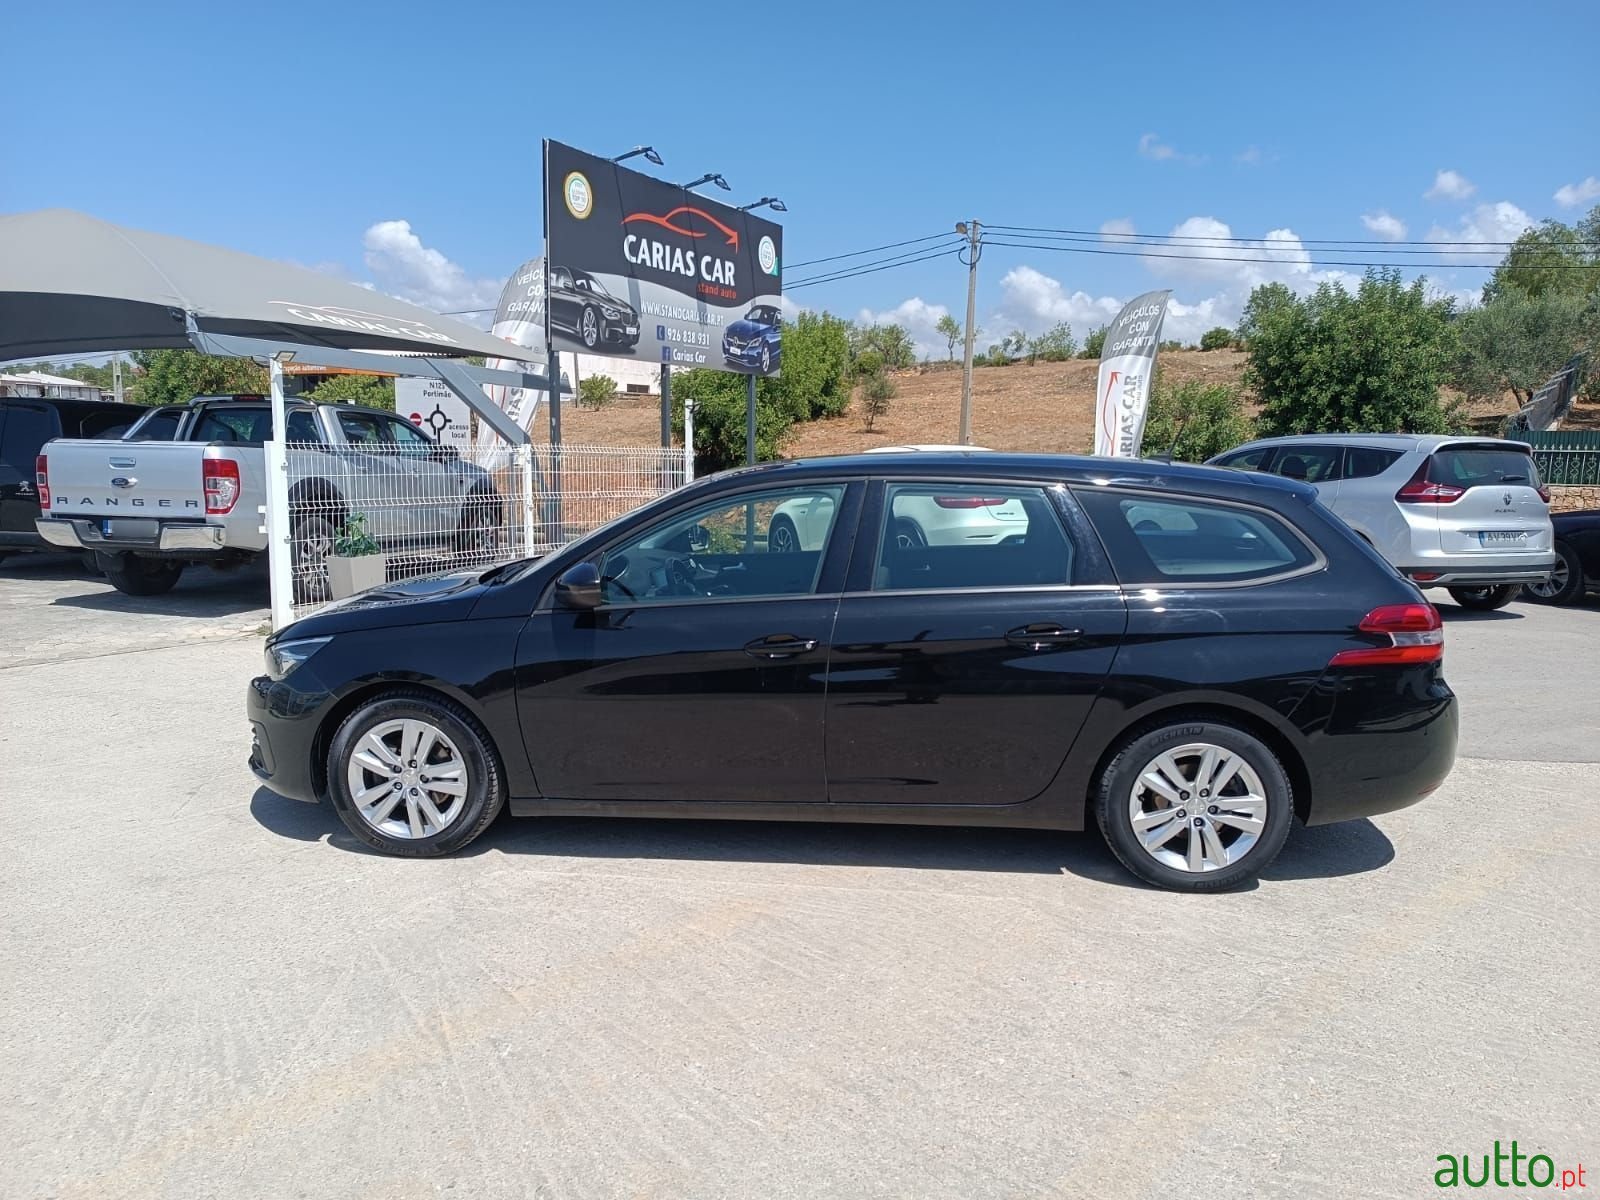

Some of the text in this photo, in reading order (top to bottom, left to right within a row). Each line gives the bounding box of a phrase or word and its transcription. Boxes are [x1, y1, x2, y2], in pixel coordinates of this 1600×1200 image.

[623, 234, 696, 277] CARIAS
[700, 255, 736, 286] CAR
[720, 286, 737, 299] auto
[287, 308, 400, 335] CARIAS
[1128, 321, 1150, 334] COM
[667, 327, 710, 346] 926 838 931
[673, 348, 694, 362] Carias
[695, 351, 706, 363] Car
[423, 389, 452, 398] Portimão
[1120, 375, 1138, 457] RIAS CAR
[451, 431, 467, 439] local
[56, 496, 199, 508] RANGER
